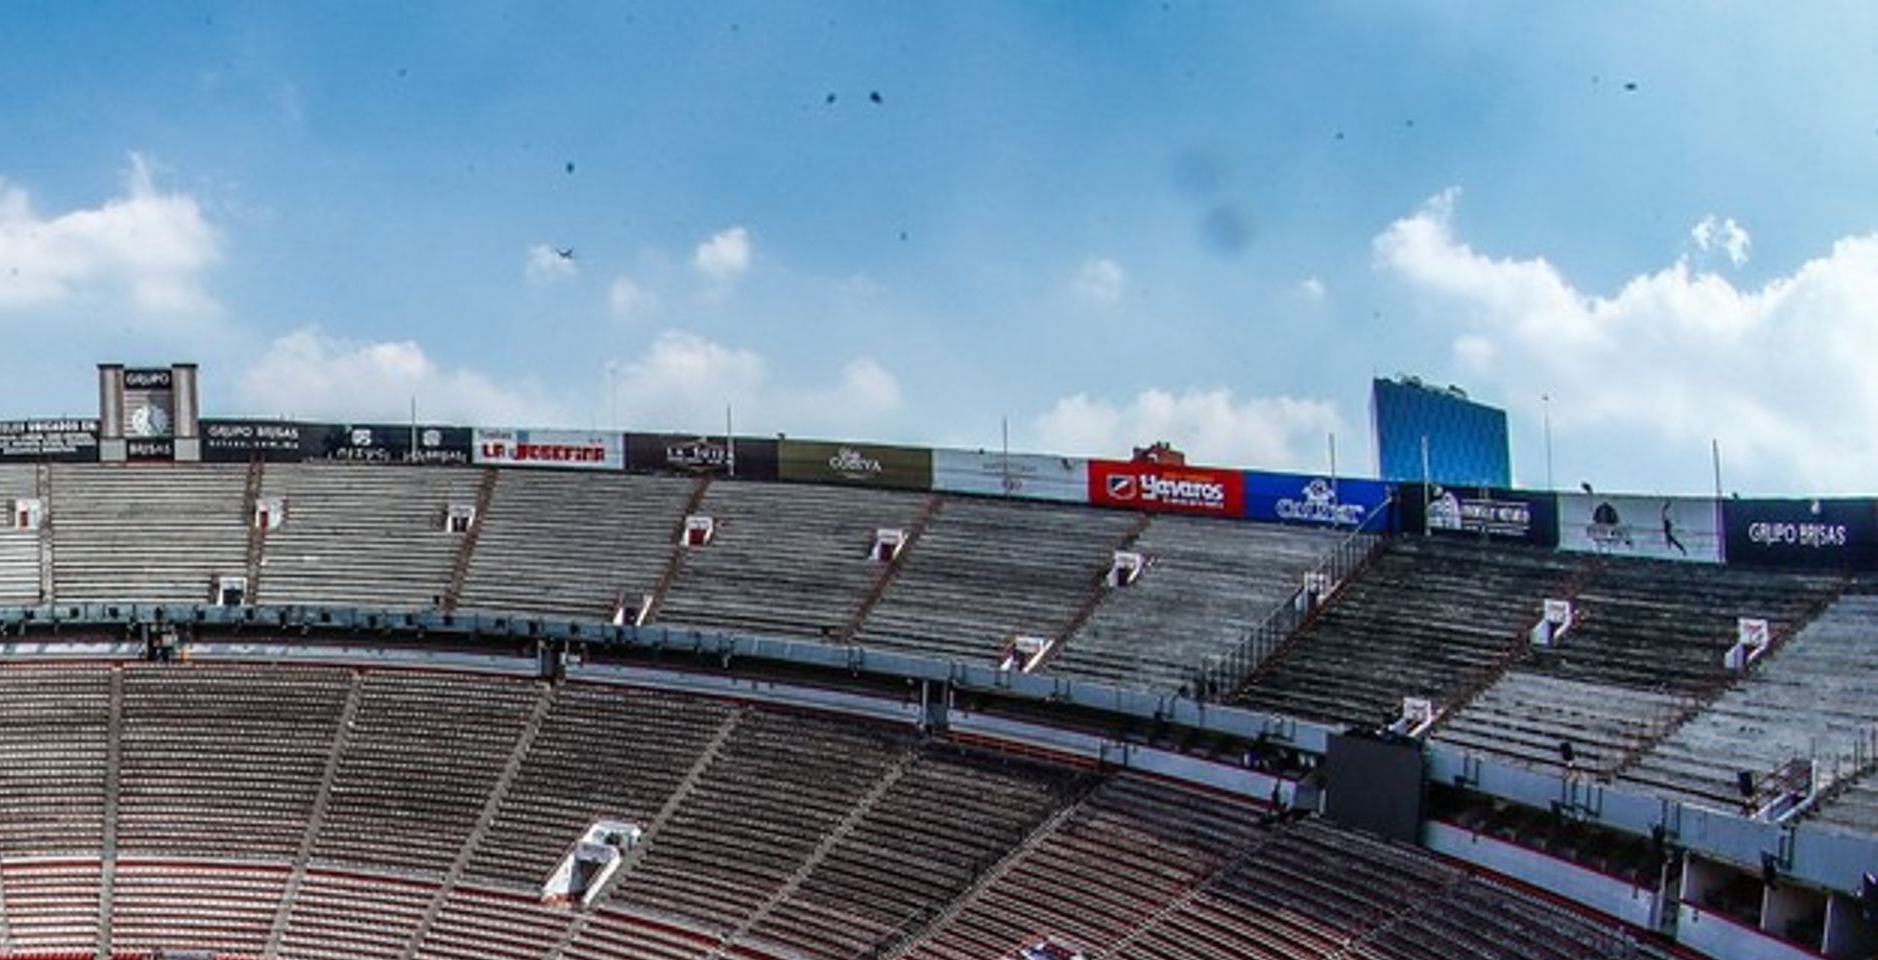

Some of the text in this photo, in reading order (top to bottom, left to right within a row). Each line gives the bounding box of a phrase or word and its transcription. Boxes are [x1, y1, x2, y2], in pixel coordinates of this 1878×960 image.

[126, 372, 170, 388] GRUPO
[208, 424, 299, 440] GRUPO BRISAS
[129, 442, 172, 456] BRISAS
[1748, 521, 1847, 549] GRUPO BRISAS
